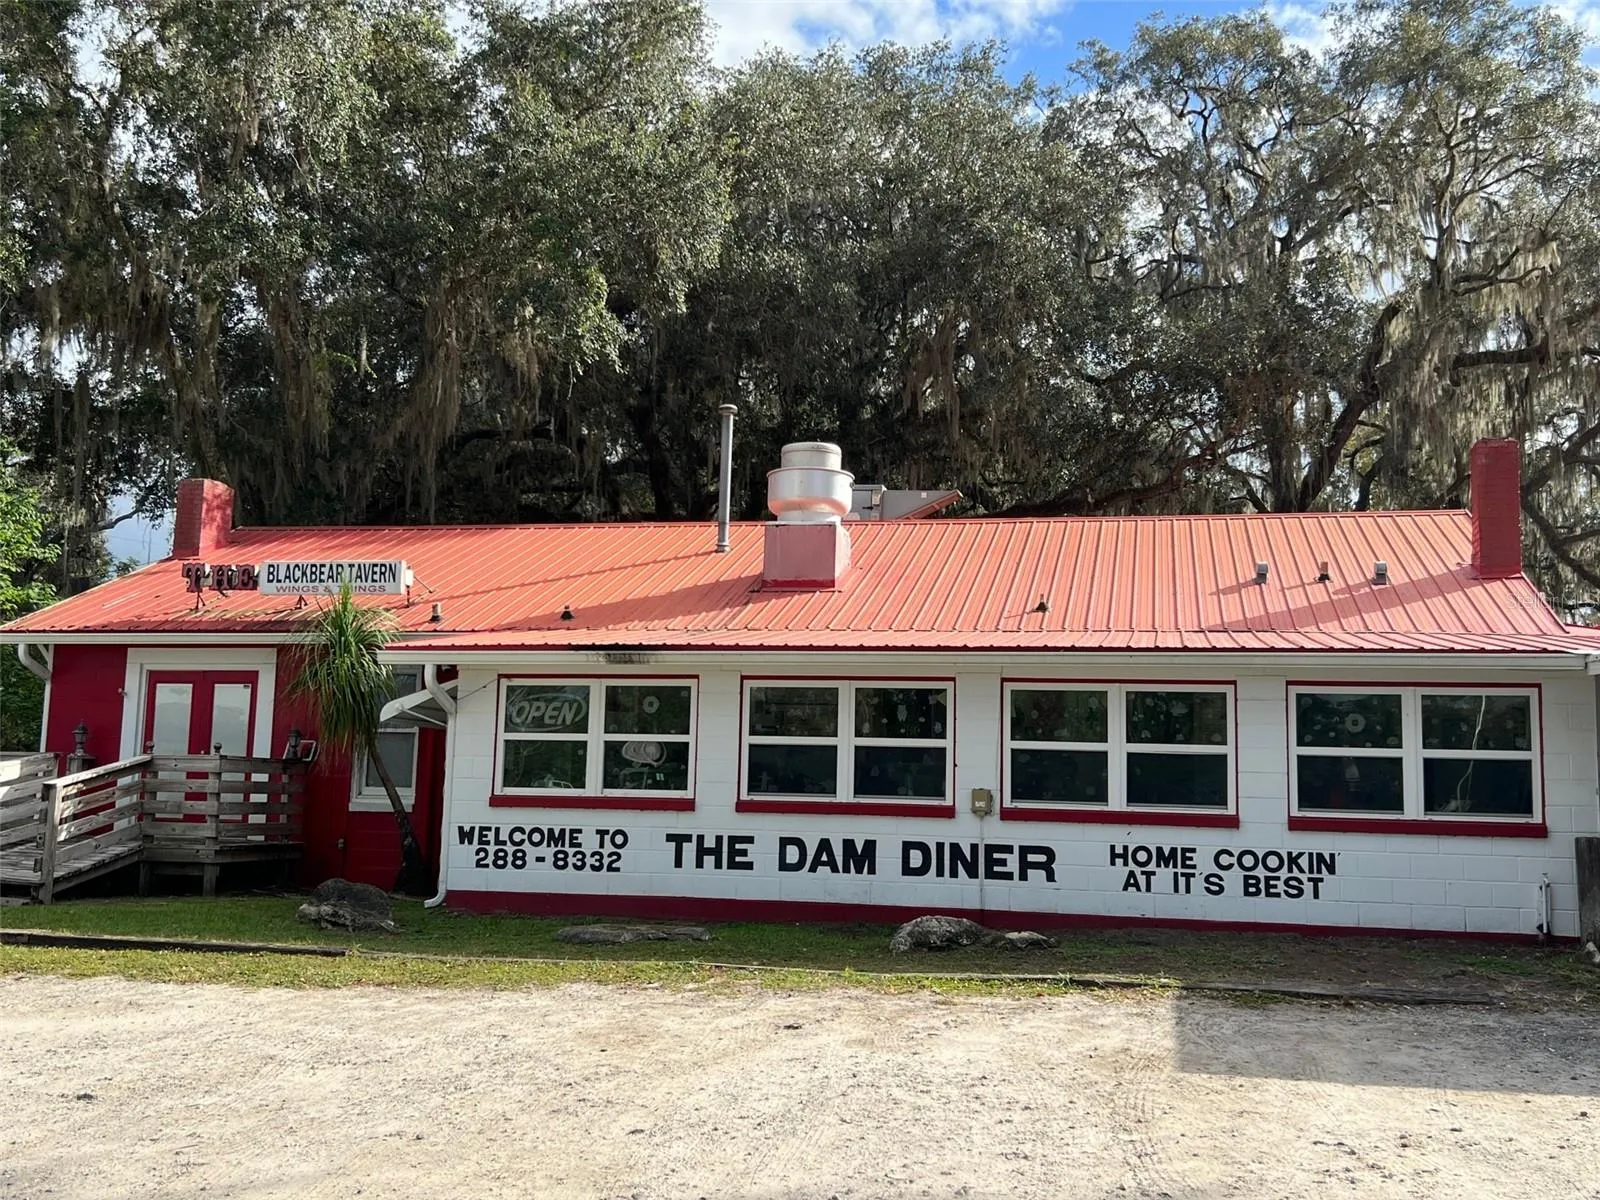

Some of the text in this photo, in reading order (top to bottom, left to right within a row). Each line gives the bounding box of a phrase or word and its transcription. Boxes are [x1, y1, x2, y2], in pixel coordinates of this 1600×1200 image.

[266, 563, 397, 584] BLACKBEAR TAVERN
[275, 584, 320, 593] WINGS
[511, 700, 579, 726] OPEN
[457, 825, 629, 850] WELCOME TO
[666, 833, 1057, 883] THE DAM DINER
[1109, 844, 1341, 876] HOME COOKIN'
[1121, 869, 1325, 900] AT IT'S BEST
